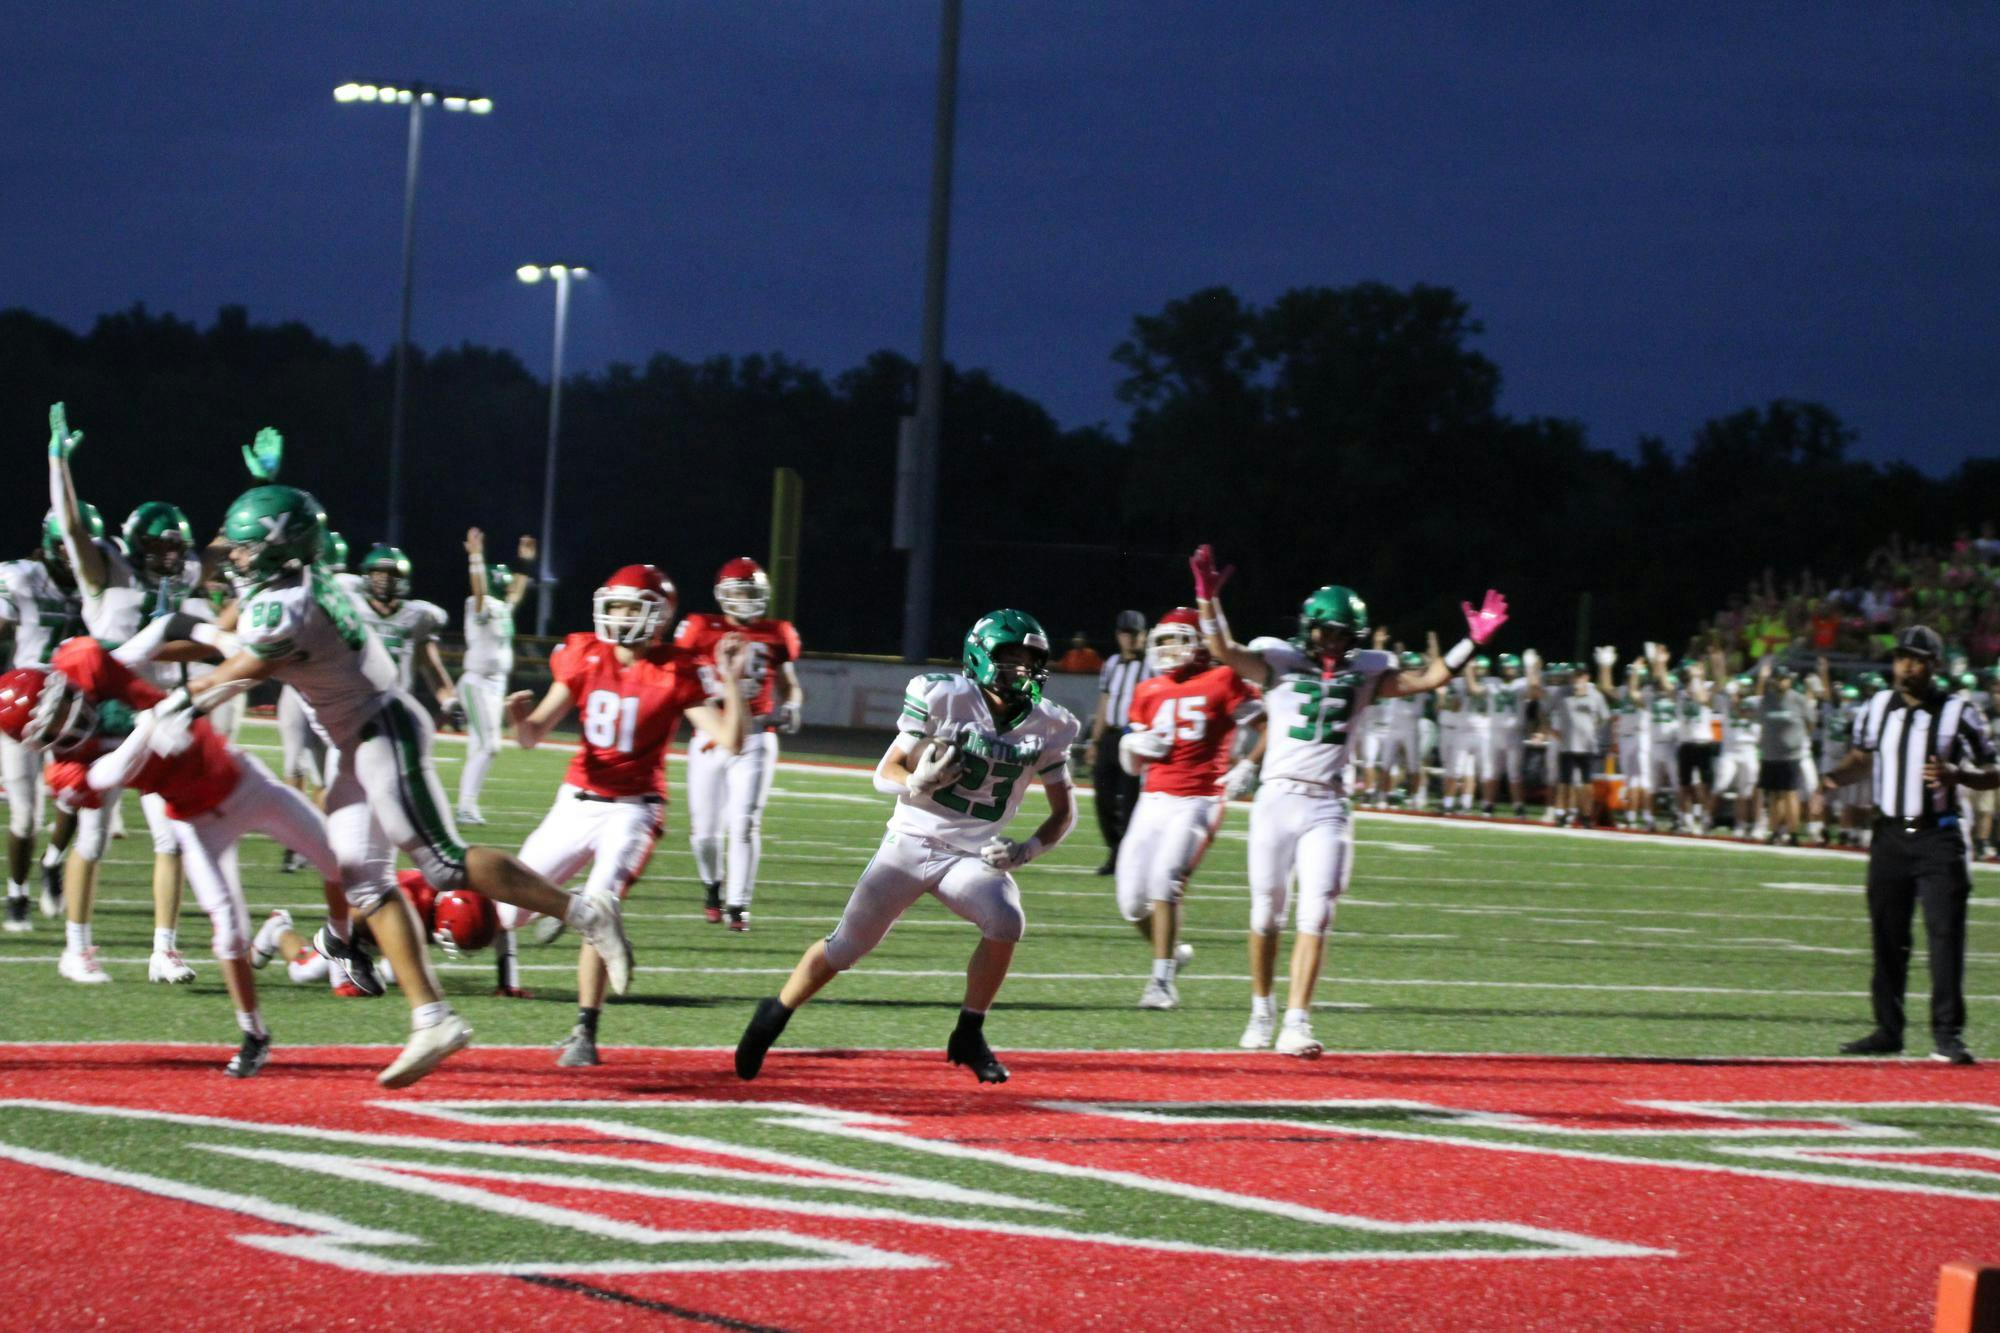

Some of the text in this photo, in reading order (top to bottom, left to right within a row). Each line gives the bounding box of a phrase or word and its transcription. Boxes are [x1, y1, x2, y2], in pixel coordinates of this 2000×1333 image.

[584, 689, 640, 753] 81
[1153, 696, 1206, 743] 45
[931, 751, 1024, 822] 23
